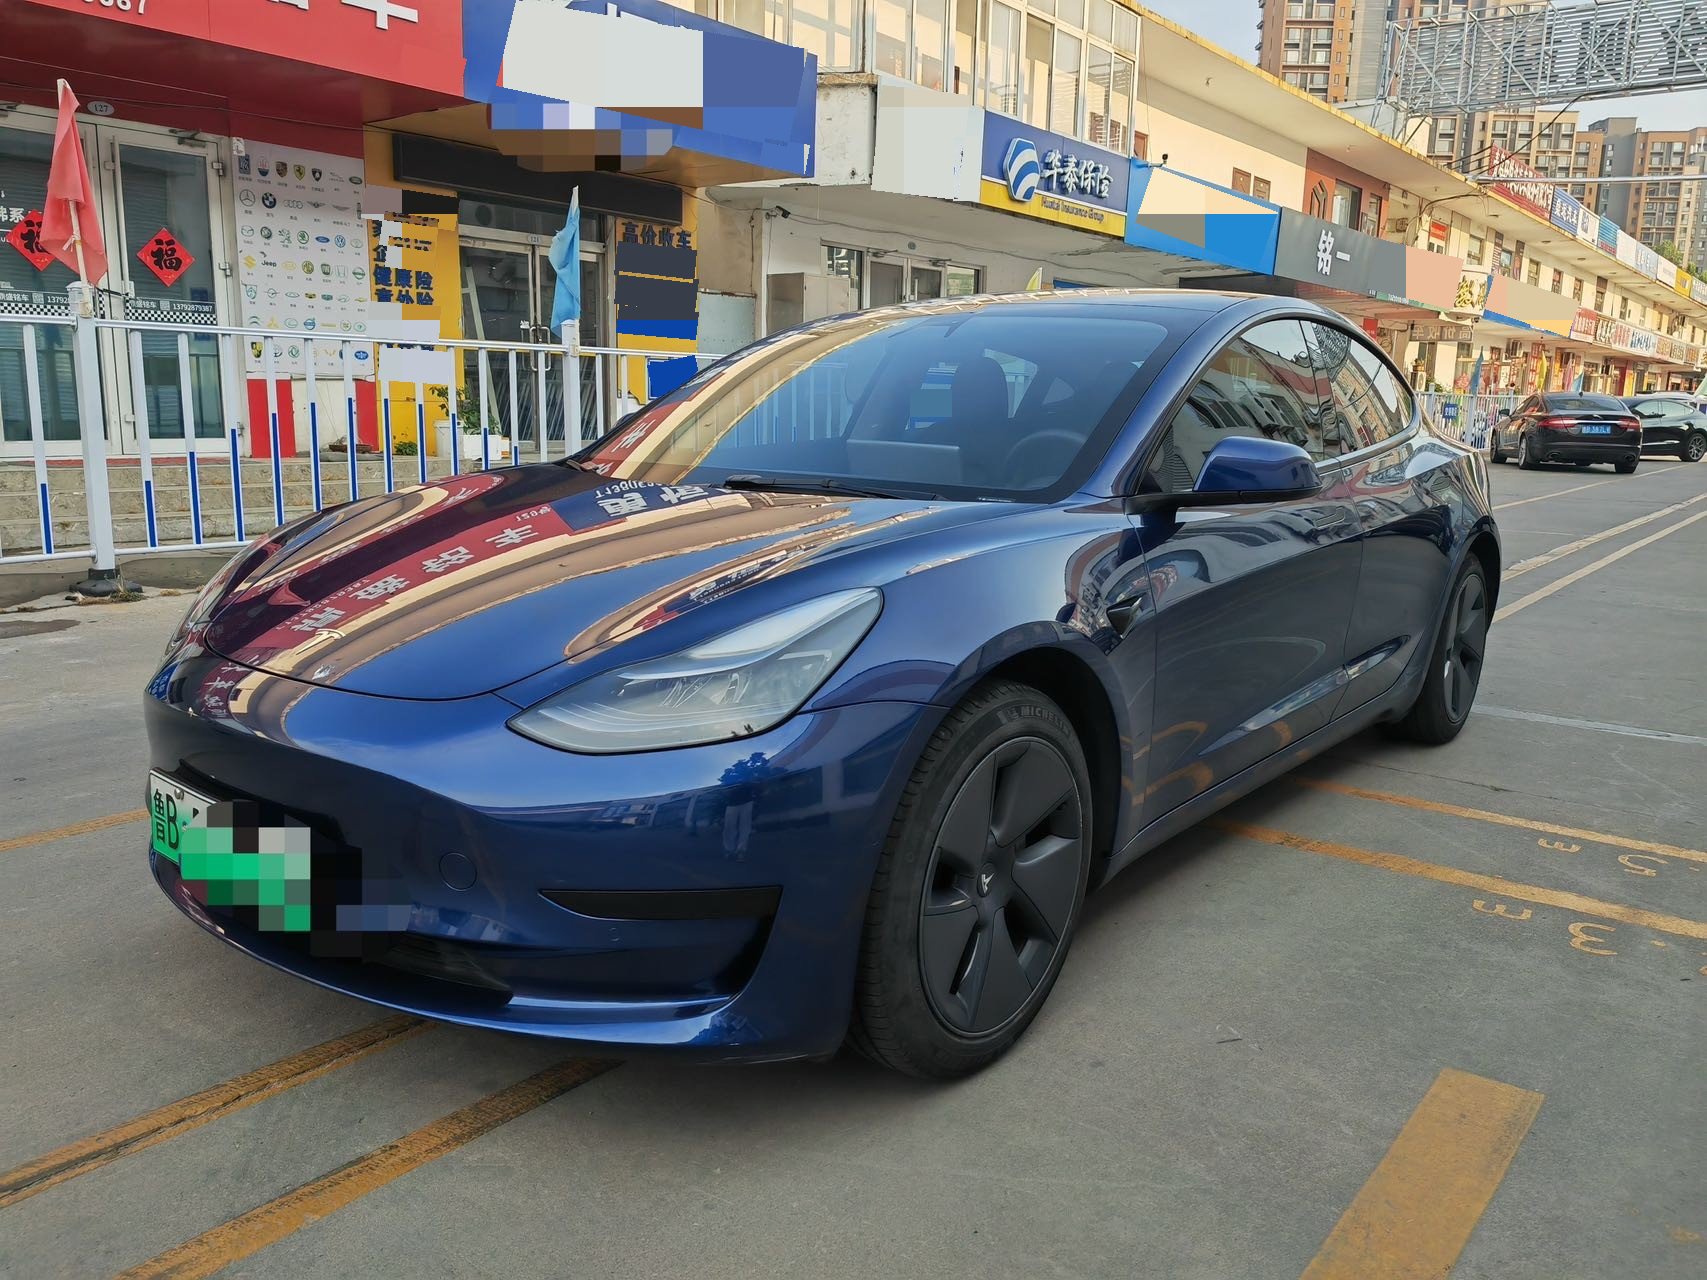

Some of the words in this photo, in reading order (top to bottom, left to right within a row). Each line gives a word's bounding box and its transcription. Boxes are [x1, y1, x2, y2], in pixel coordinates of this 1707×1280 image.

[94, 104, 108, 112] 127
[1041, 149, 1114, 198] 华泰保险
[1042, 196, 1060, 210] Huatai
[1061, 201, 1088, 217] Insurance
[1088, 208, 1105, 224] Group
[621, 222, 692, 248] 高价收车
[150, 238, 183, 272] 福
[261, 260, 277, 268] Jeep
[373, 264, 434, 291] 健康险
[172, 303, 213, 313] 13792879387
